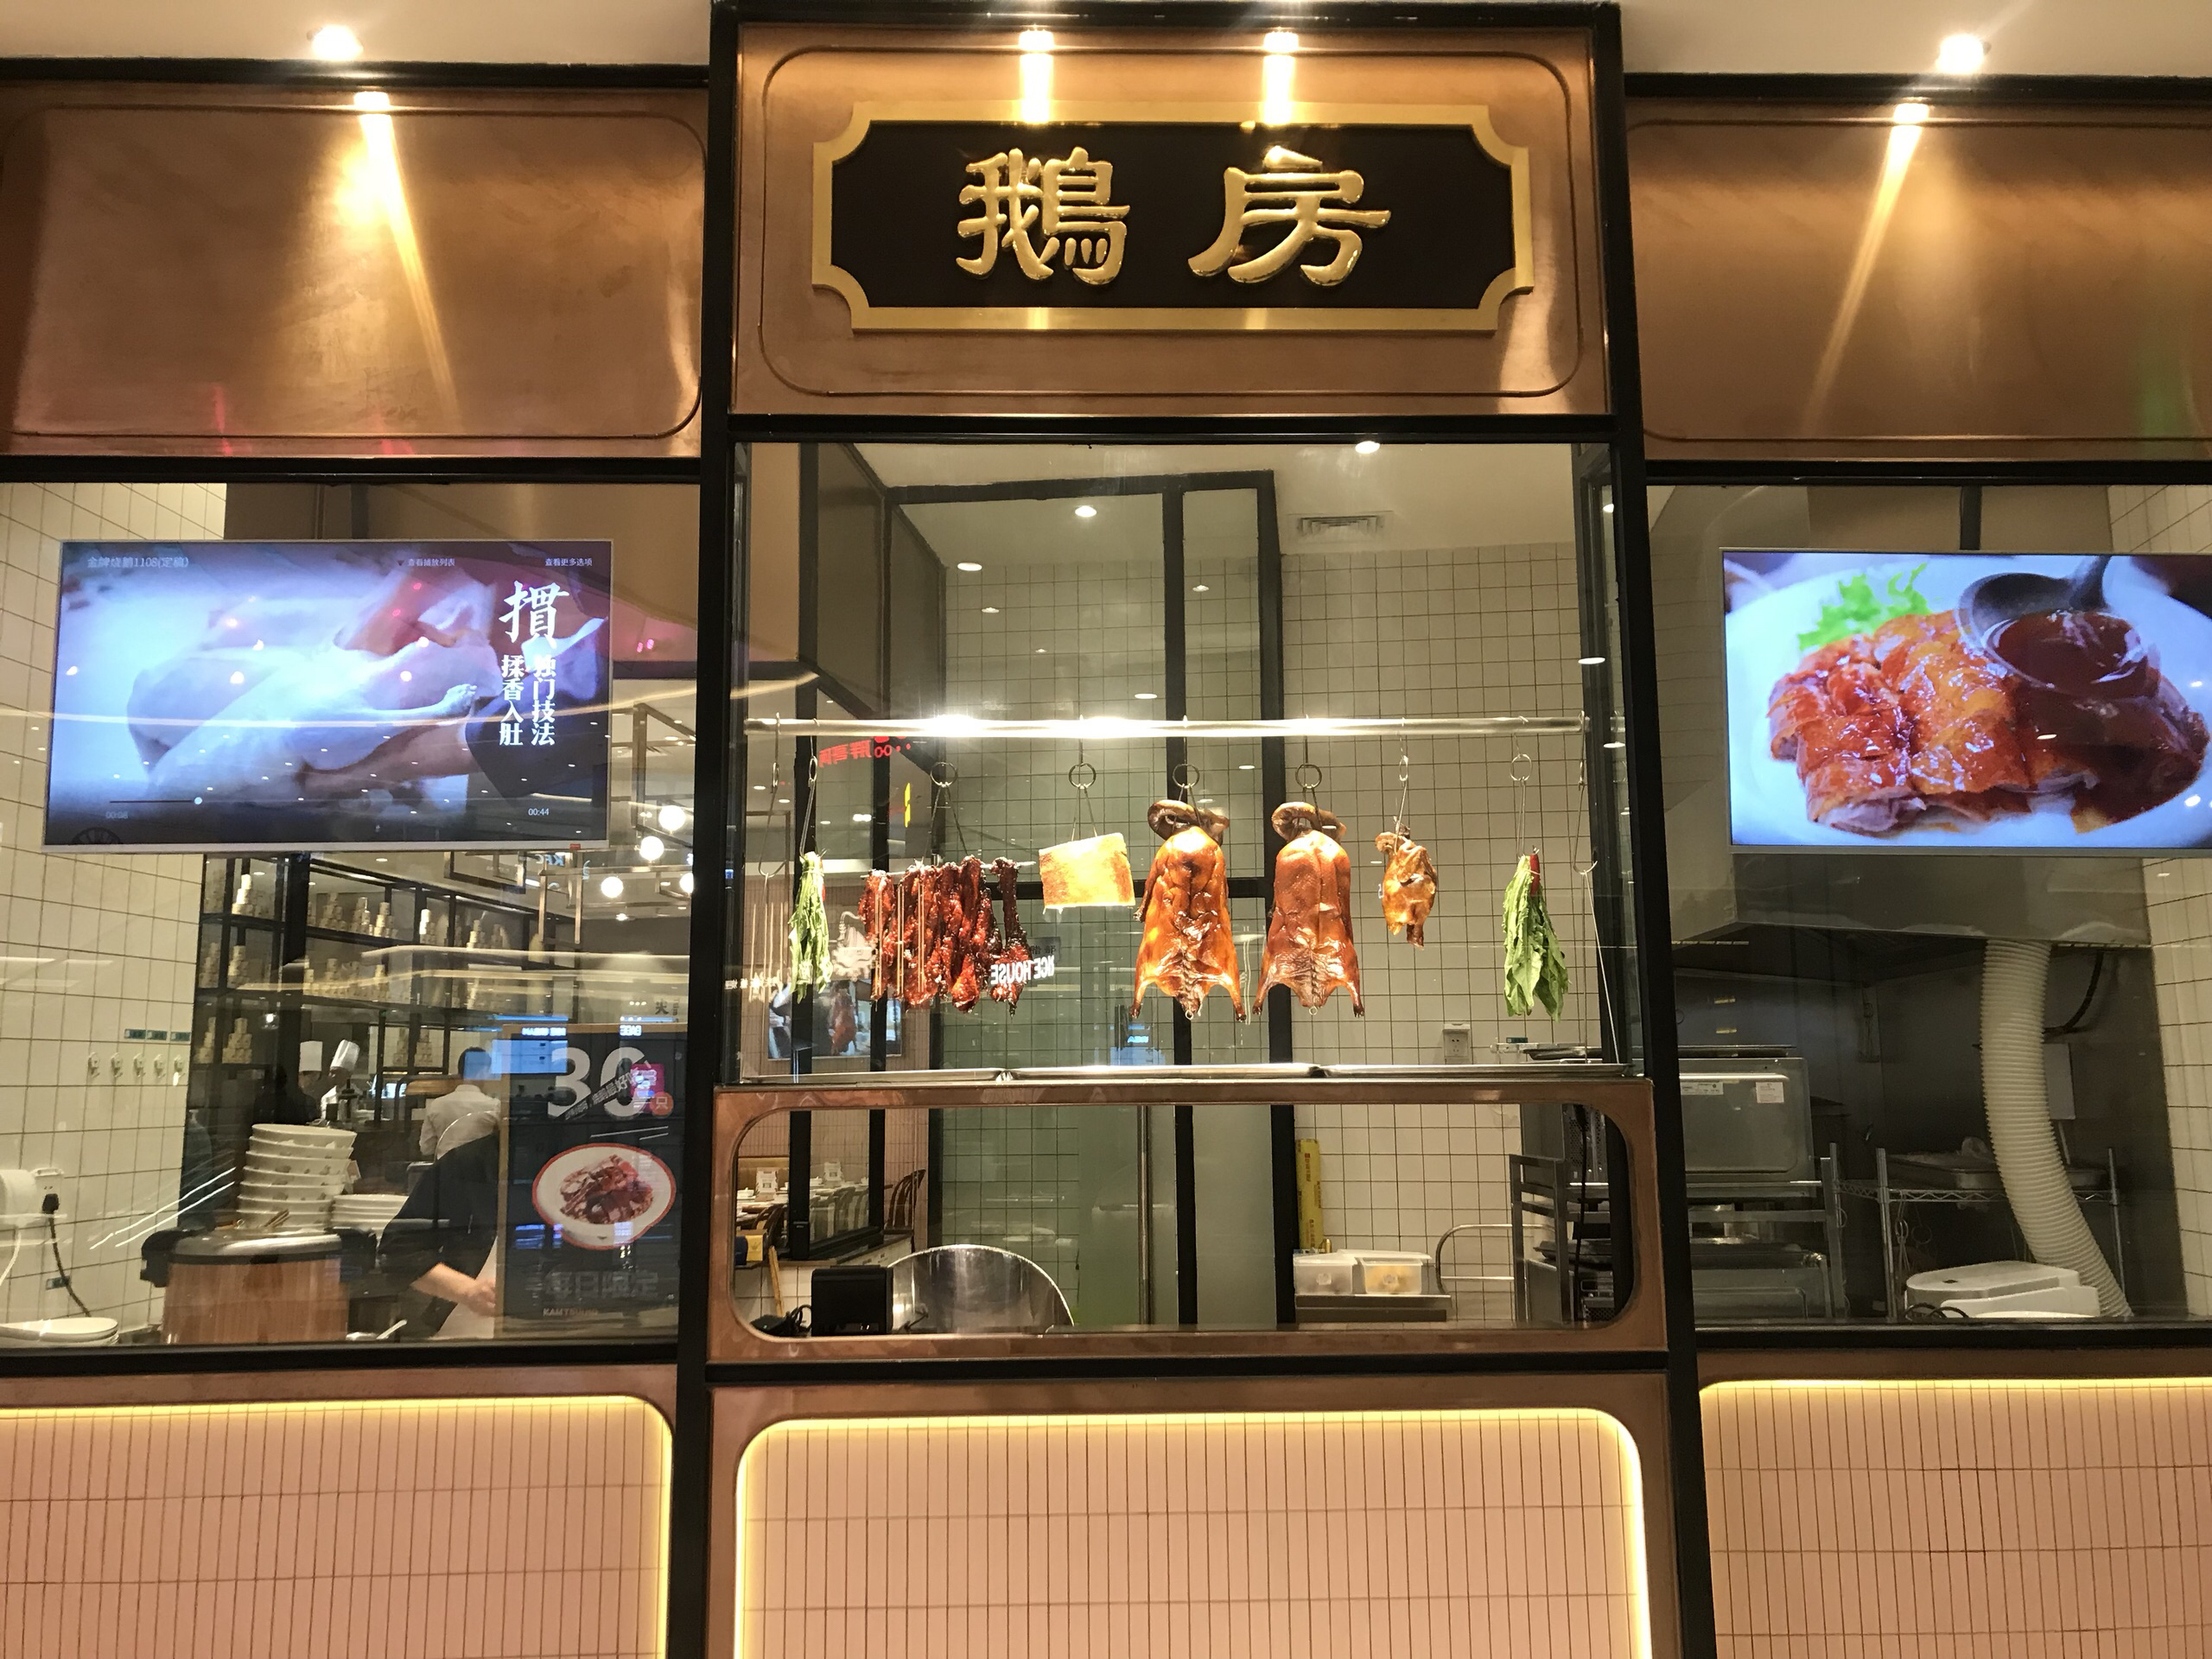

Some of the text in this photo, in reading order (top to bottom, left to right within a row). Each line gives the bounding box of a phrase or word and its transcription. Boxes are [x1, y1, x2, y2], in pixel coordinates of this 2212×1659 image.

[544, 557, 593, 567] 查看更多选项
[499, 654, 525, 747] 揉香入肚
[531, 654, 557, 747] 独门技法
